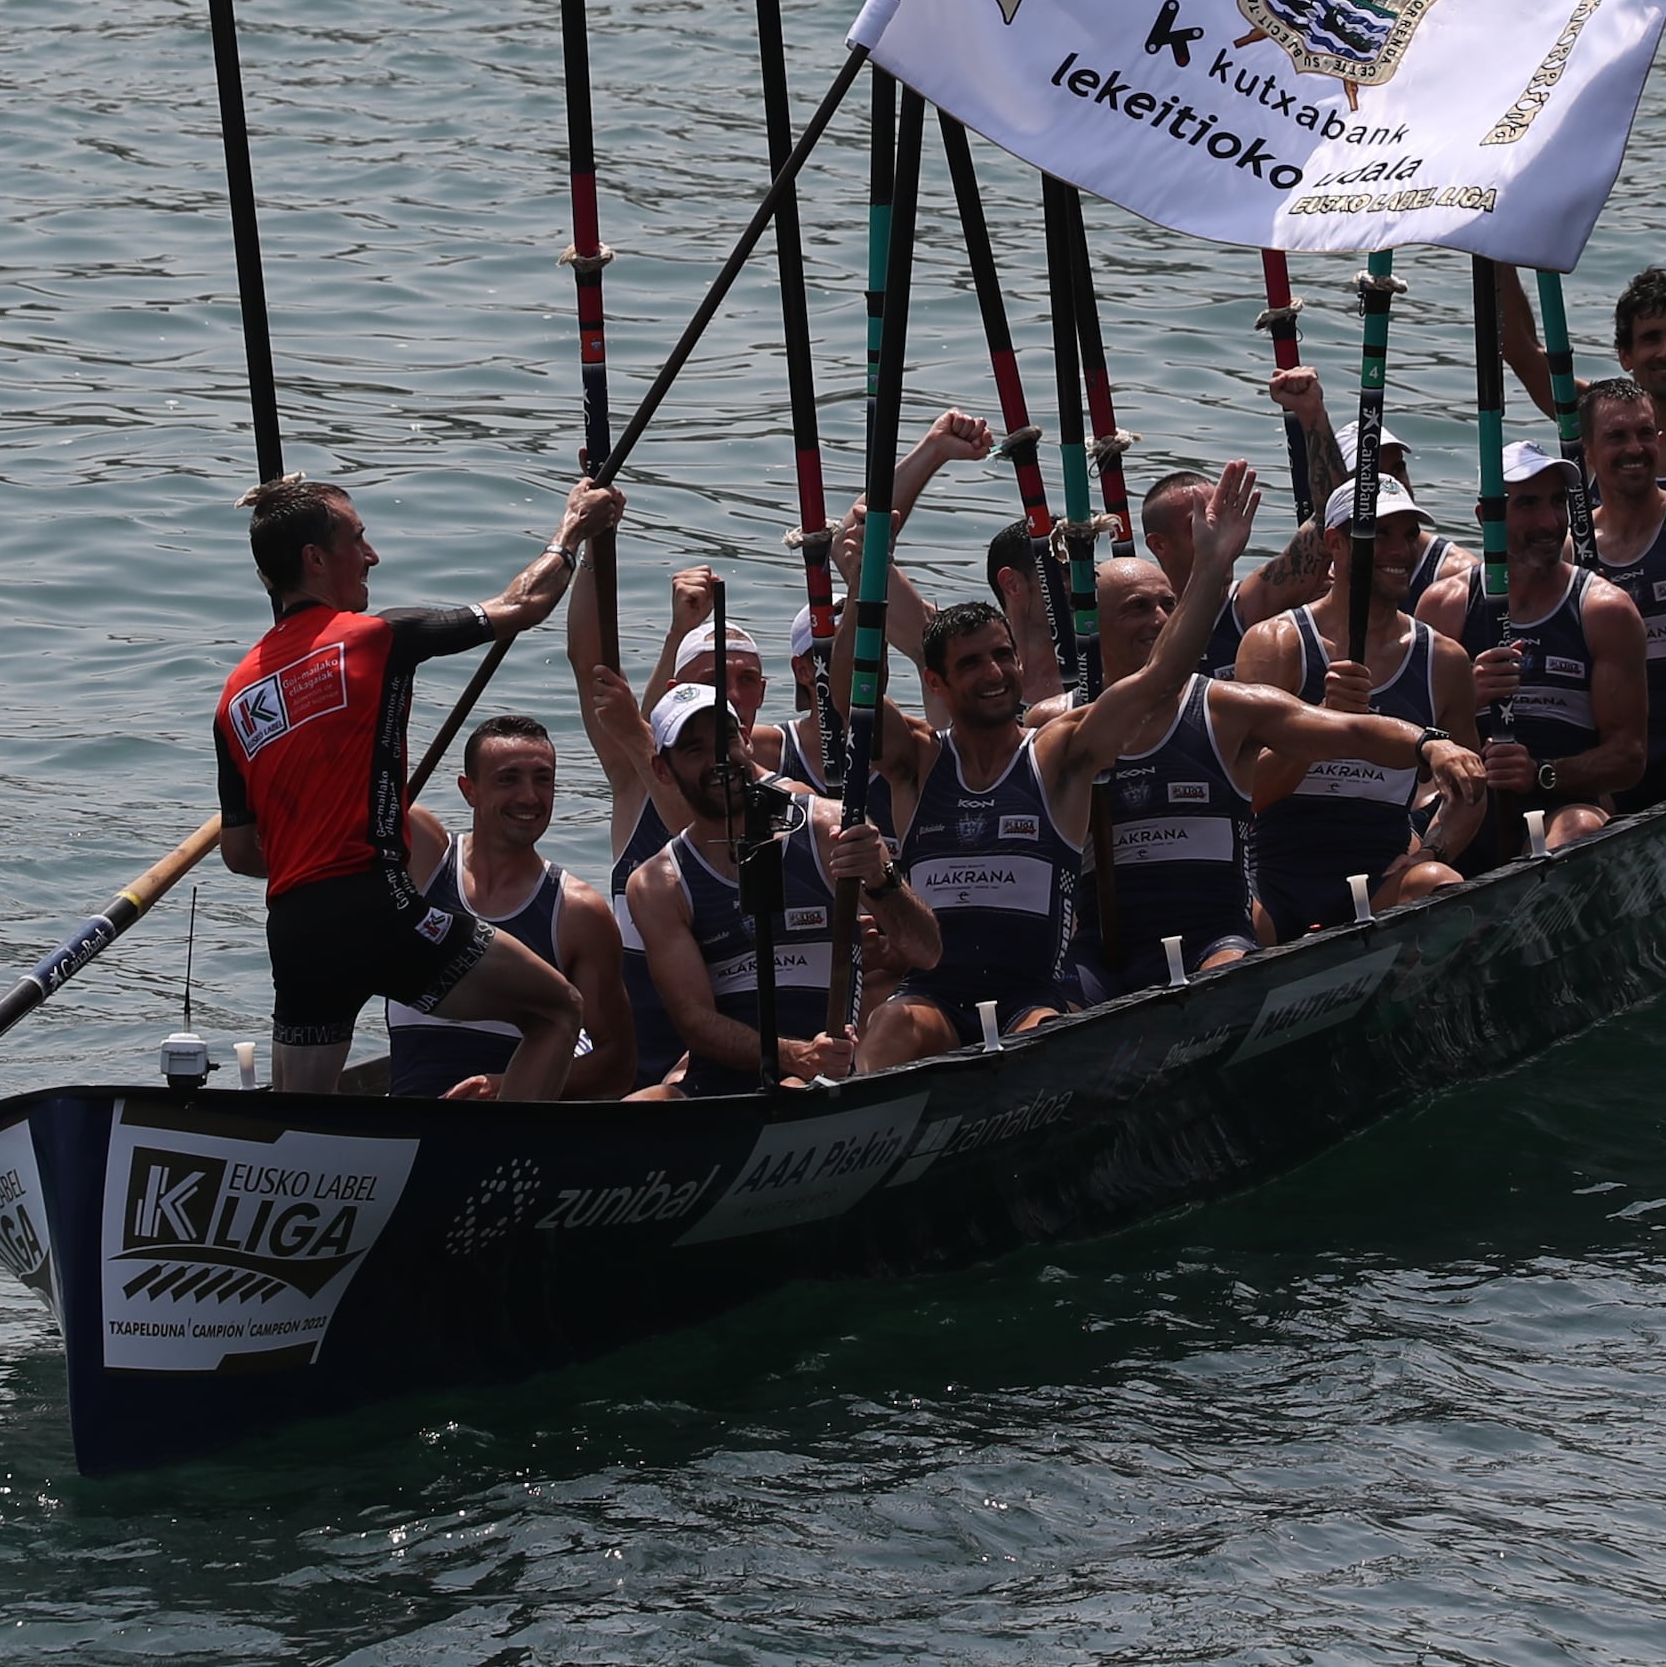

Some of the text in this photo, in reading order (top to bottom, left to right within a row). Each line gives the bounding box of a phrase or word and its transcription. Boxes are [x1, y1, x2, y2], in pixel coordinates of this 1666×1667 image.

[1207, 48, 1410, 145] kutxabank
[1050, 52, 1304, 191] lekeitioko
[1288, 186, 1496, 216] EUSKO LABEL LIGA
[1359, 433, 1379, 522] CaixaBank
[1311, 765, 1386, 782] AKRANA
[1114, 829, 1189, 847] AKRANA
[925, 869, 1017, 888] ALAKRANA
[717, 954, 809, 978] ALAKANA
[735, 1128, 902, 1196] AAA Piskin
[228, 1163, 379, 1203] EUSKO LABEL
[534, 1163, 721, 1229] zunibal
[212, 1195, 359, 1260] LIGA
[109, 1313, 328, 1339] TXAPELDUNA CAMPIÓN CAMPEÓN 2023
